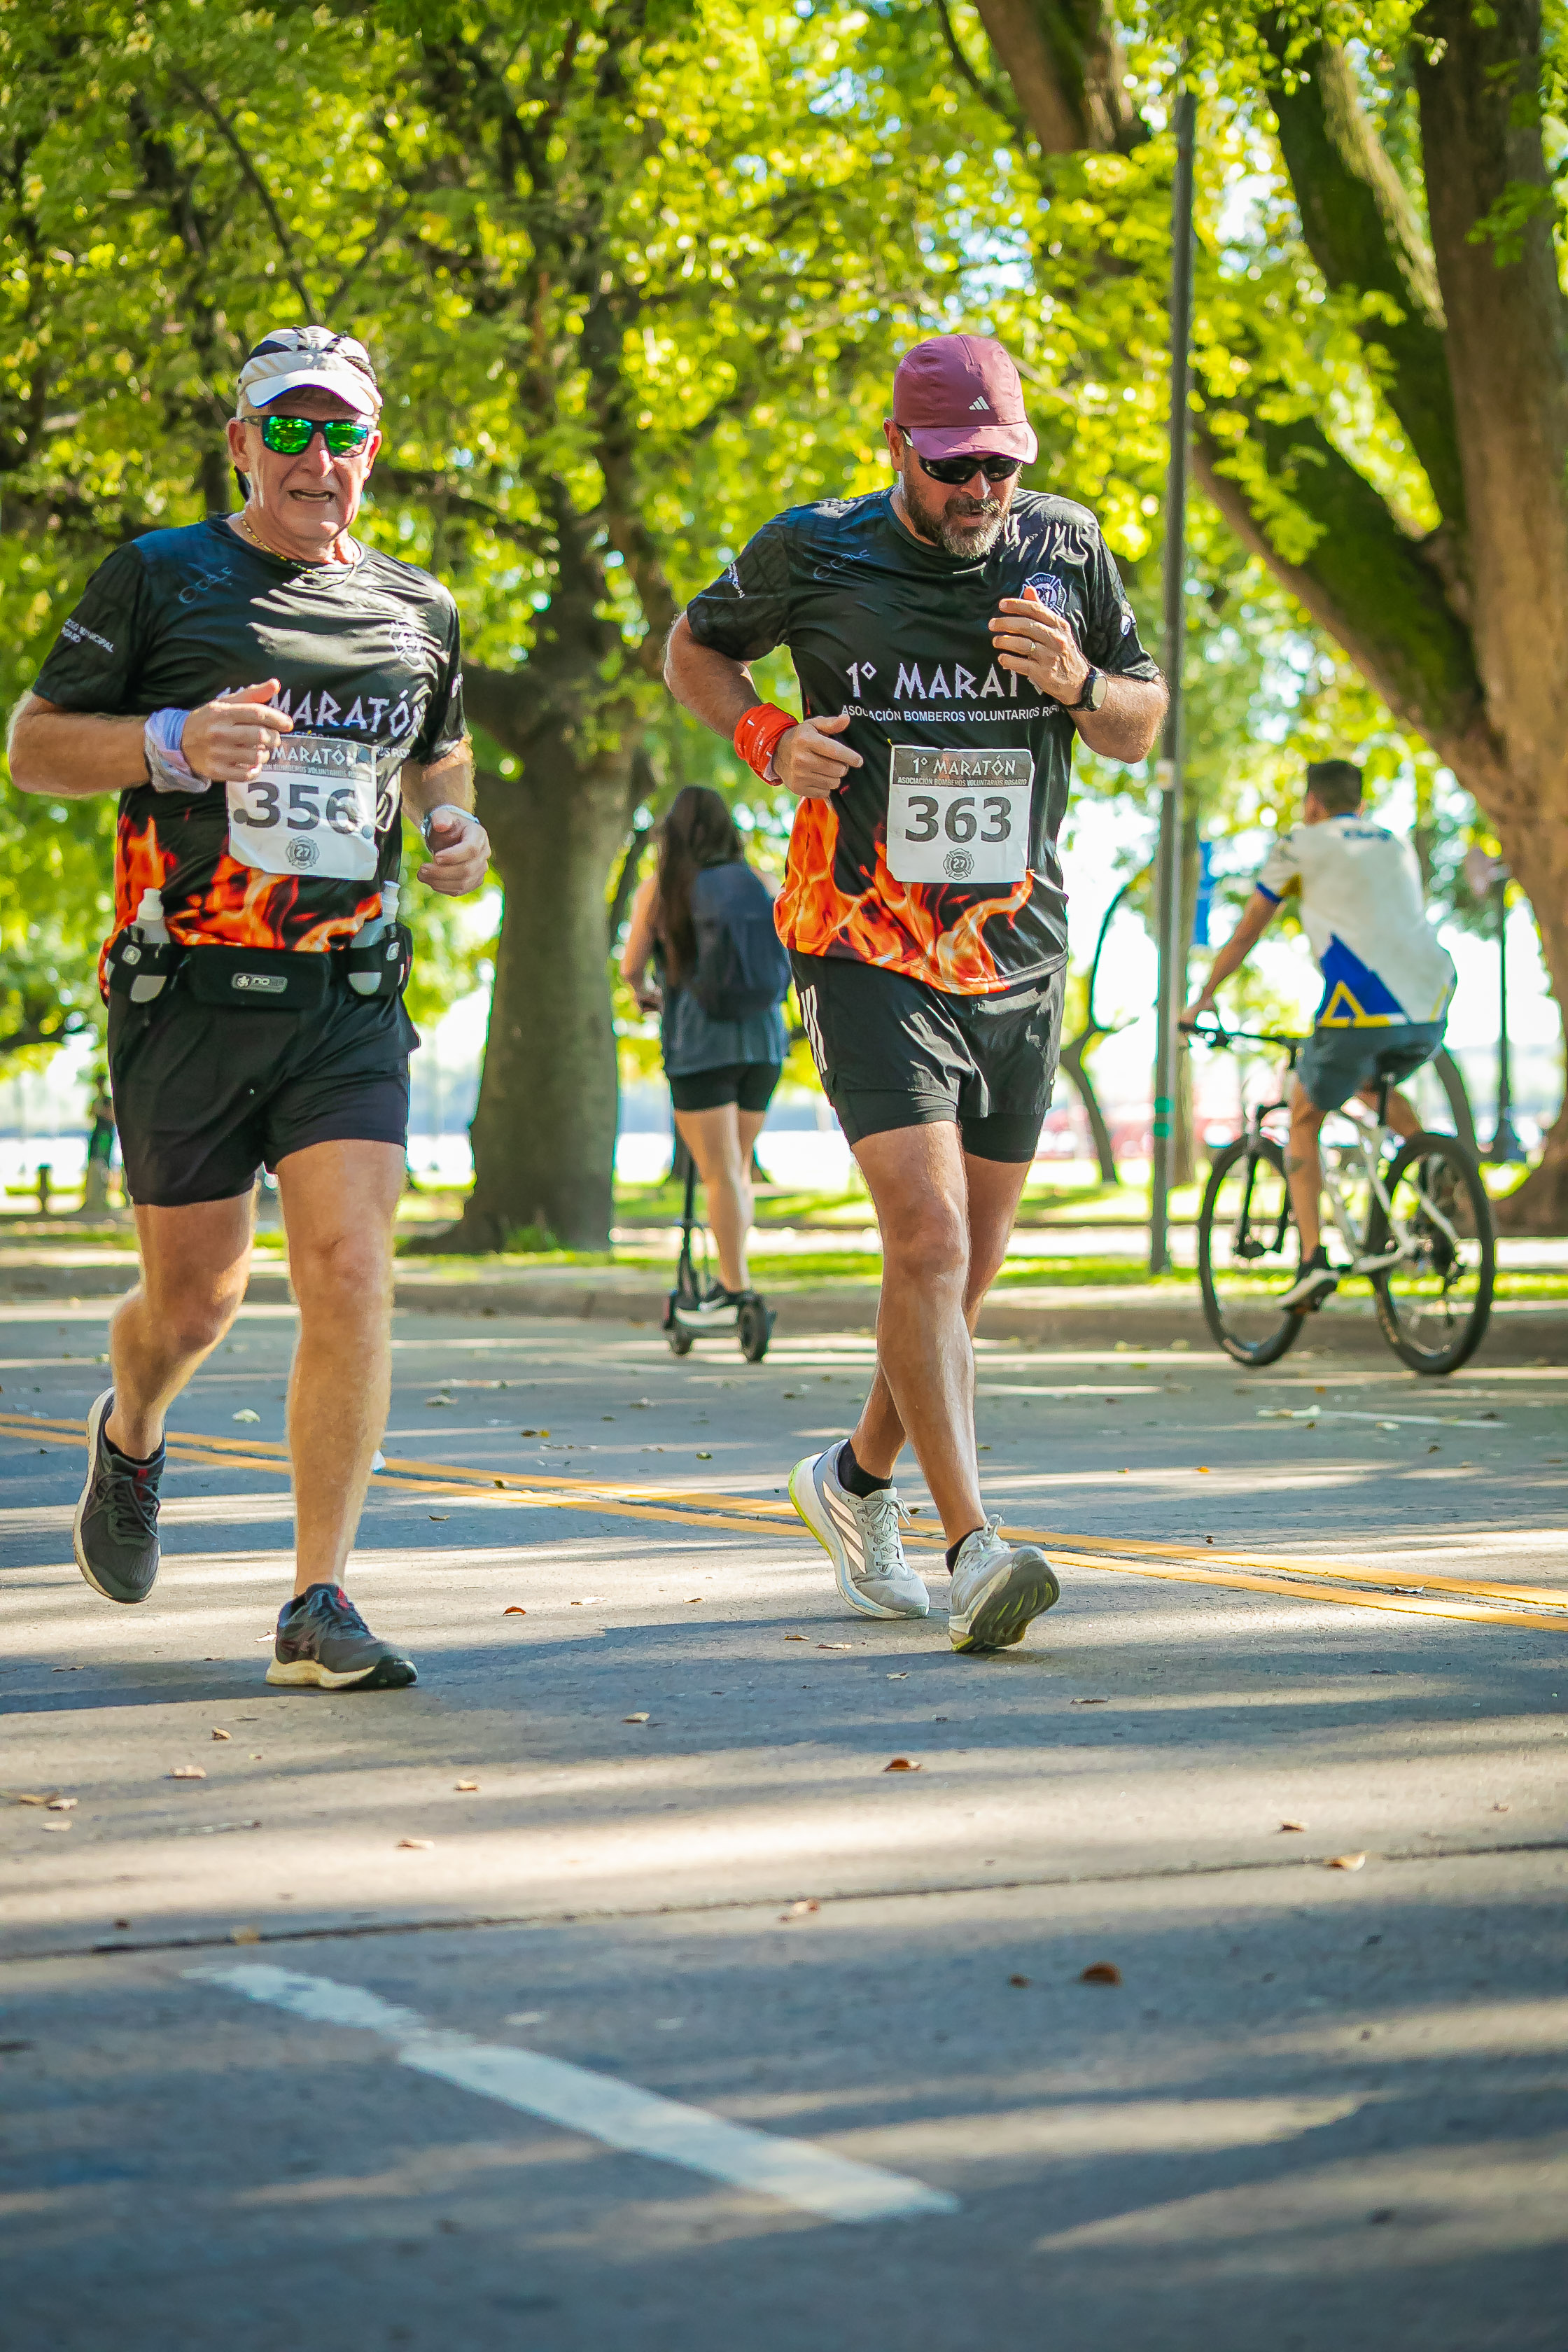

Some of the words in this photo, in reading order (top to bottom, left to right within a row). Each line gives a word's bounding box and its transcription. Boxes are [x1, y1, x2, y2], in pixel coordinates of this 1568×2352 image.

[893, 662, 1043, 699] MARAT
[904, 710, 965, 722] BOMBEROS
[967, 706, 1040, 722] VOLUNTARIOS
[932, 755, 1016, 776] MARATÓN
[934, 778, 966, 787] BOMBEROS
[967, 778, 1003, 787] VOLUNTARIOS
[247, 781, 358, 834] 356
[905, 795, 1012, 843] 363
[296, 846, 310, 858] 27
[953, 858, 966, 869] 27
